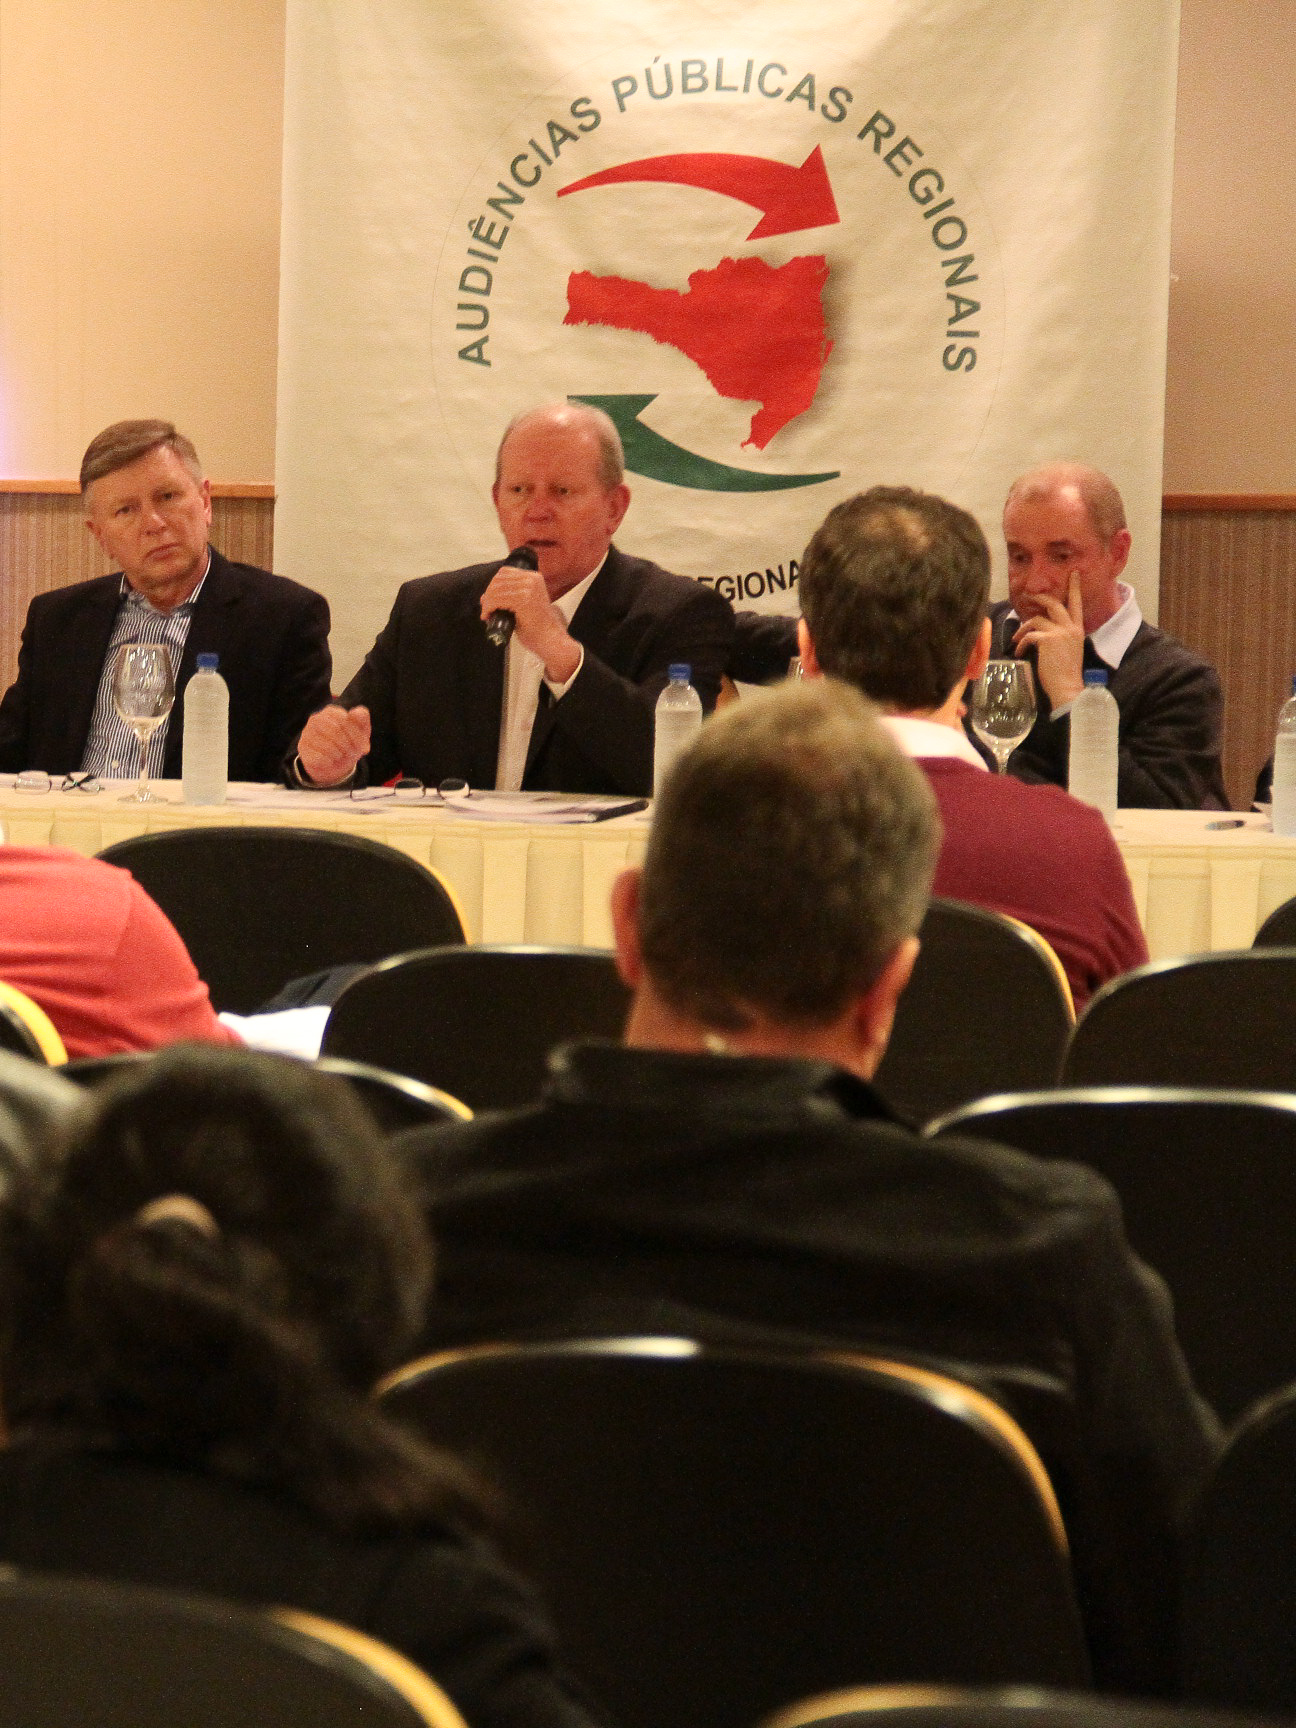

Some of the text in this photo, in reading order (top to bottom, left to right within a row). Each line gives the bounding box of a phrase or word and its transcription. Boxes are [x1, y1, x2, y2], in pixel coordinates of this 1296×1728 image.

[456, 56, 981, 373] AUDIÊNCIAS PÚBLICAS REGIONAIS
[697, 559, 800, 601] GIONA
